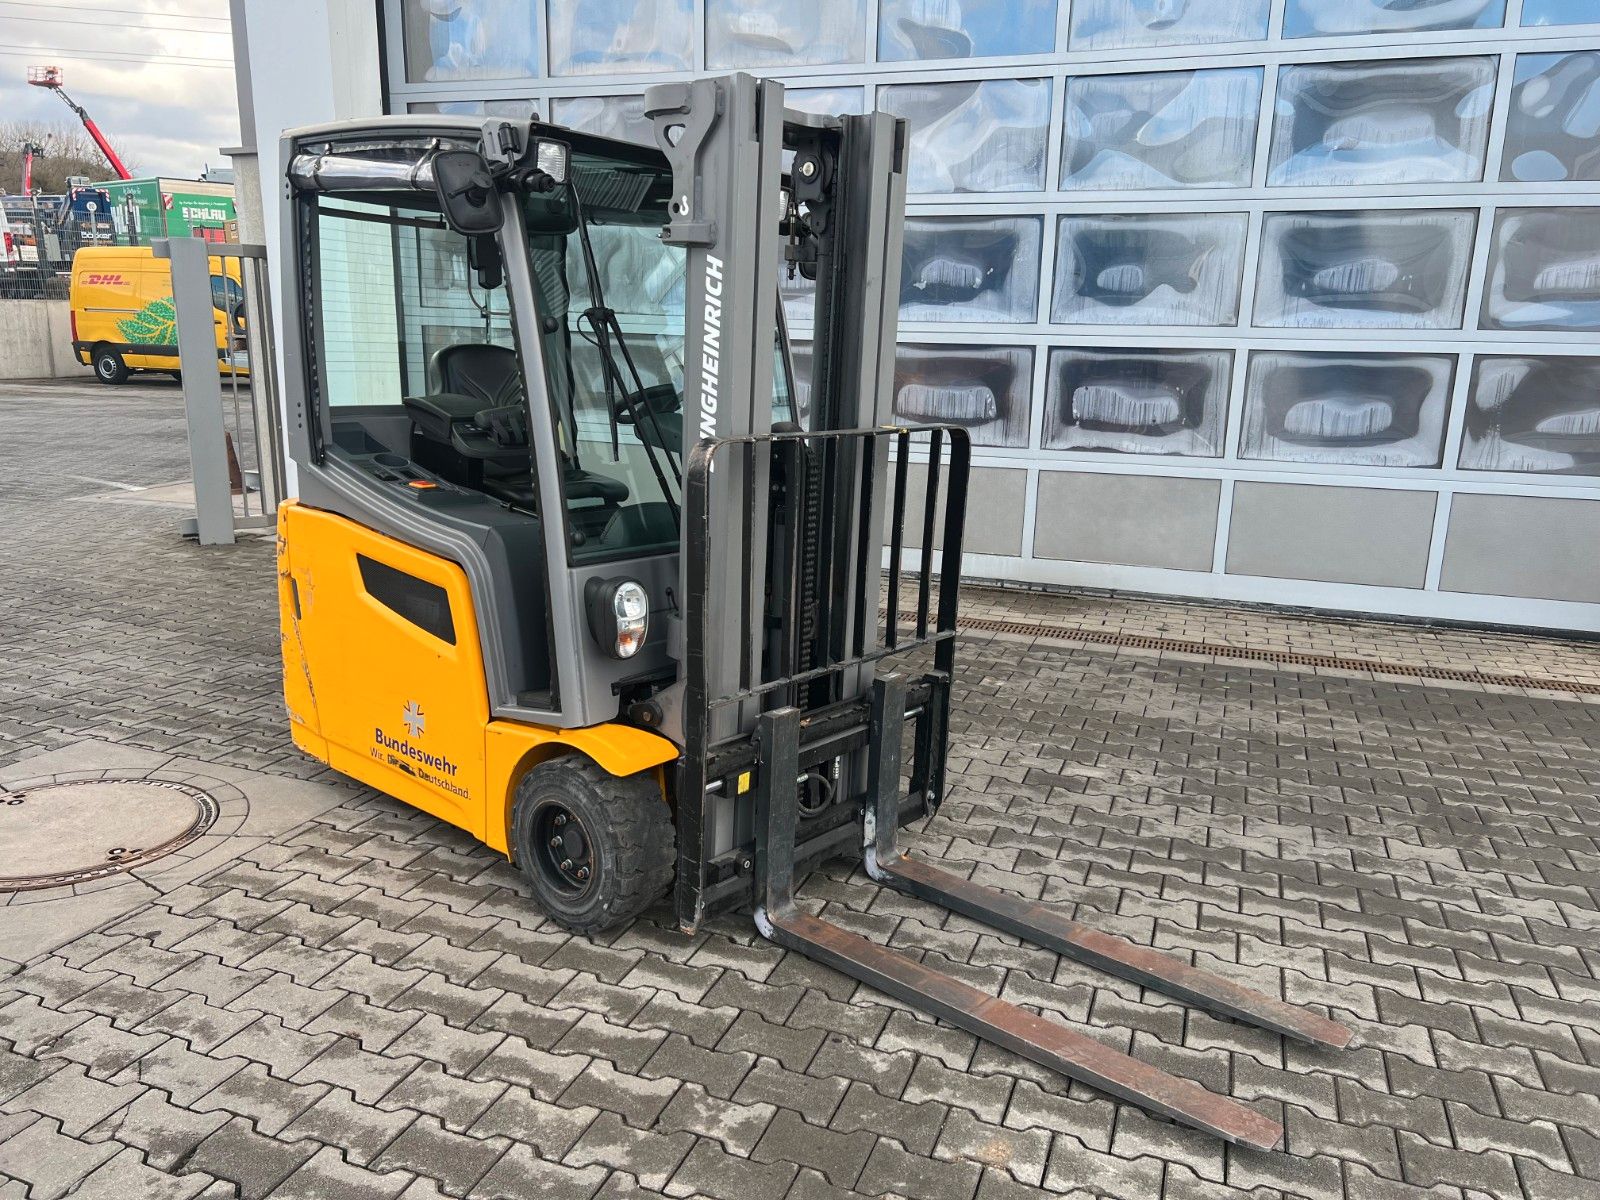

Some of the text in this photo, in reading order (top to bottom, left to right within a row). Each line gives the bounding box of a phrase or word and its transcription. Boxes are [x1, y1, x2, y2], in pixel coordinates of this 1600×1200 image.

[88, 274, 123, 284] DHL
[699, 254, 723, 473] NGHEINRICH
[375, 728, 458, 776] Bundeswehr
